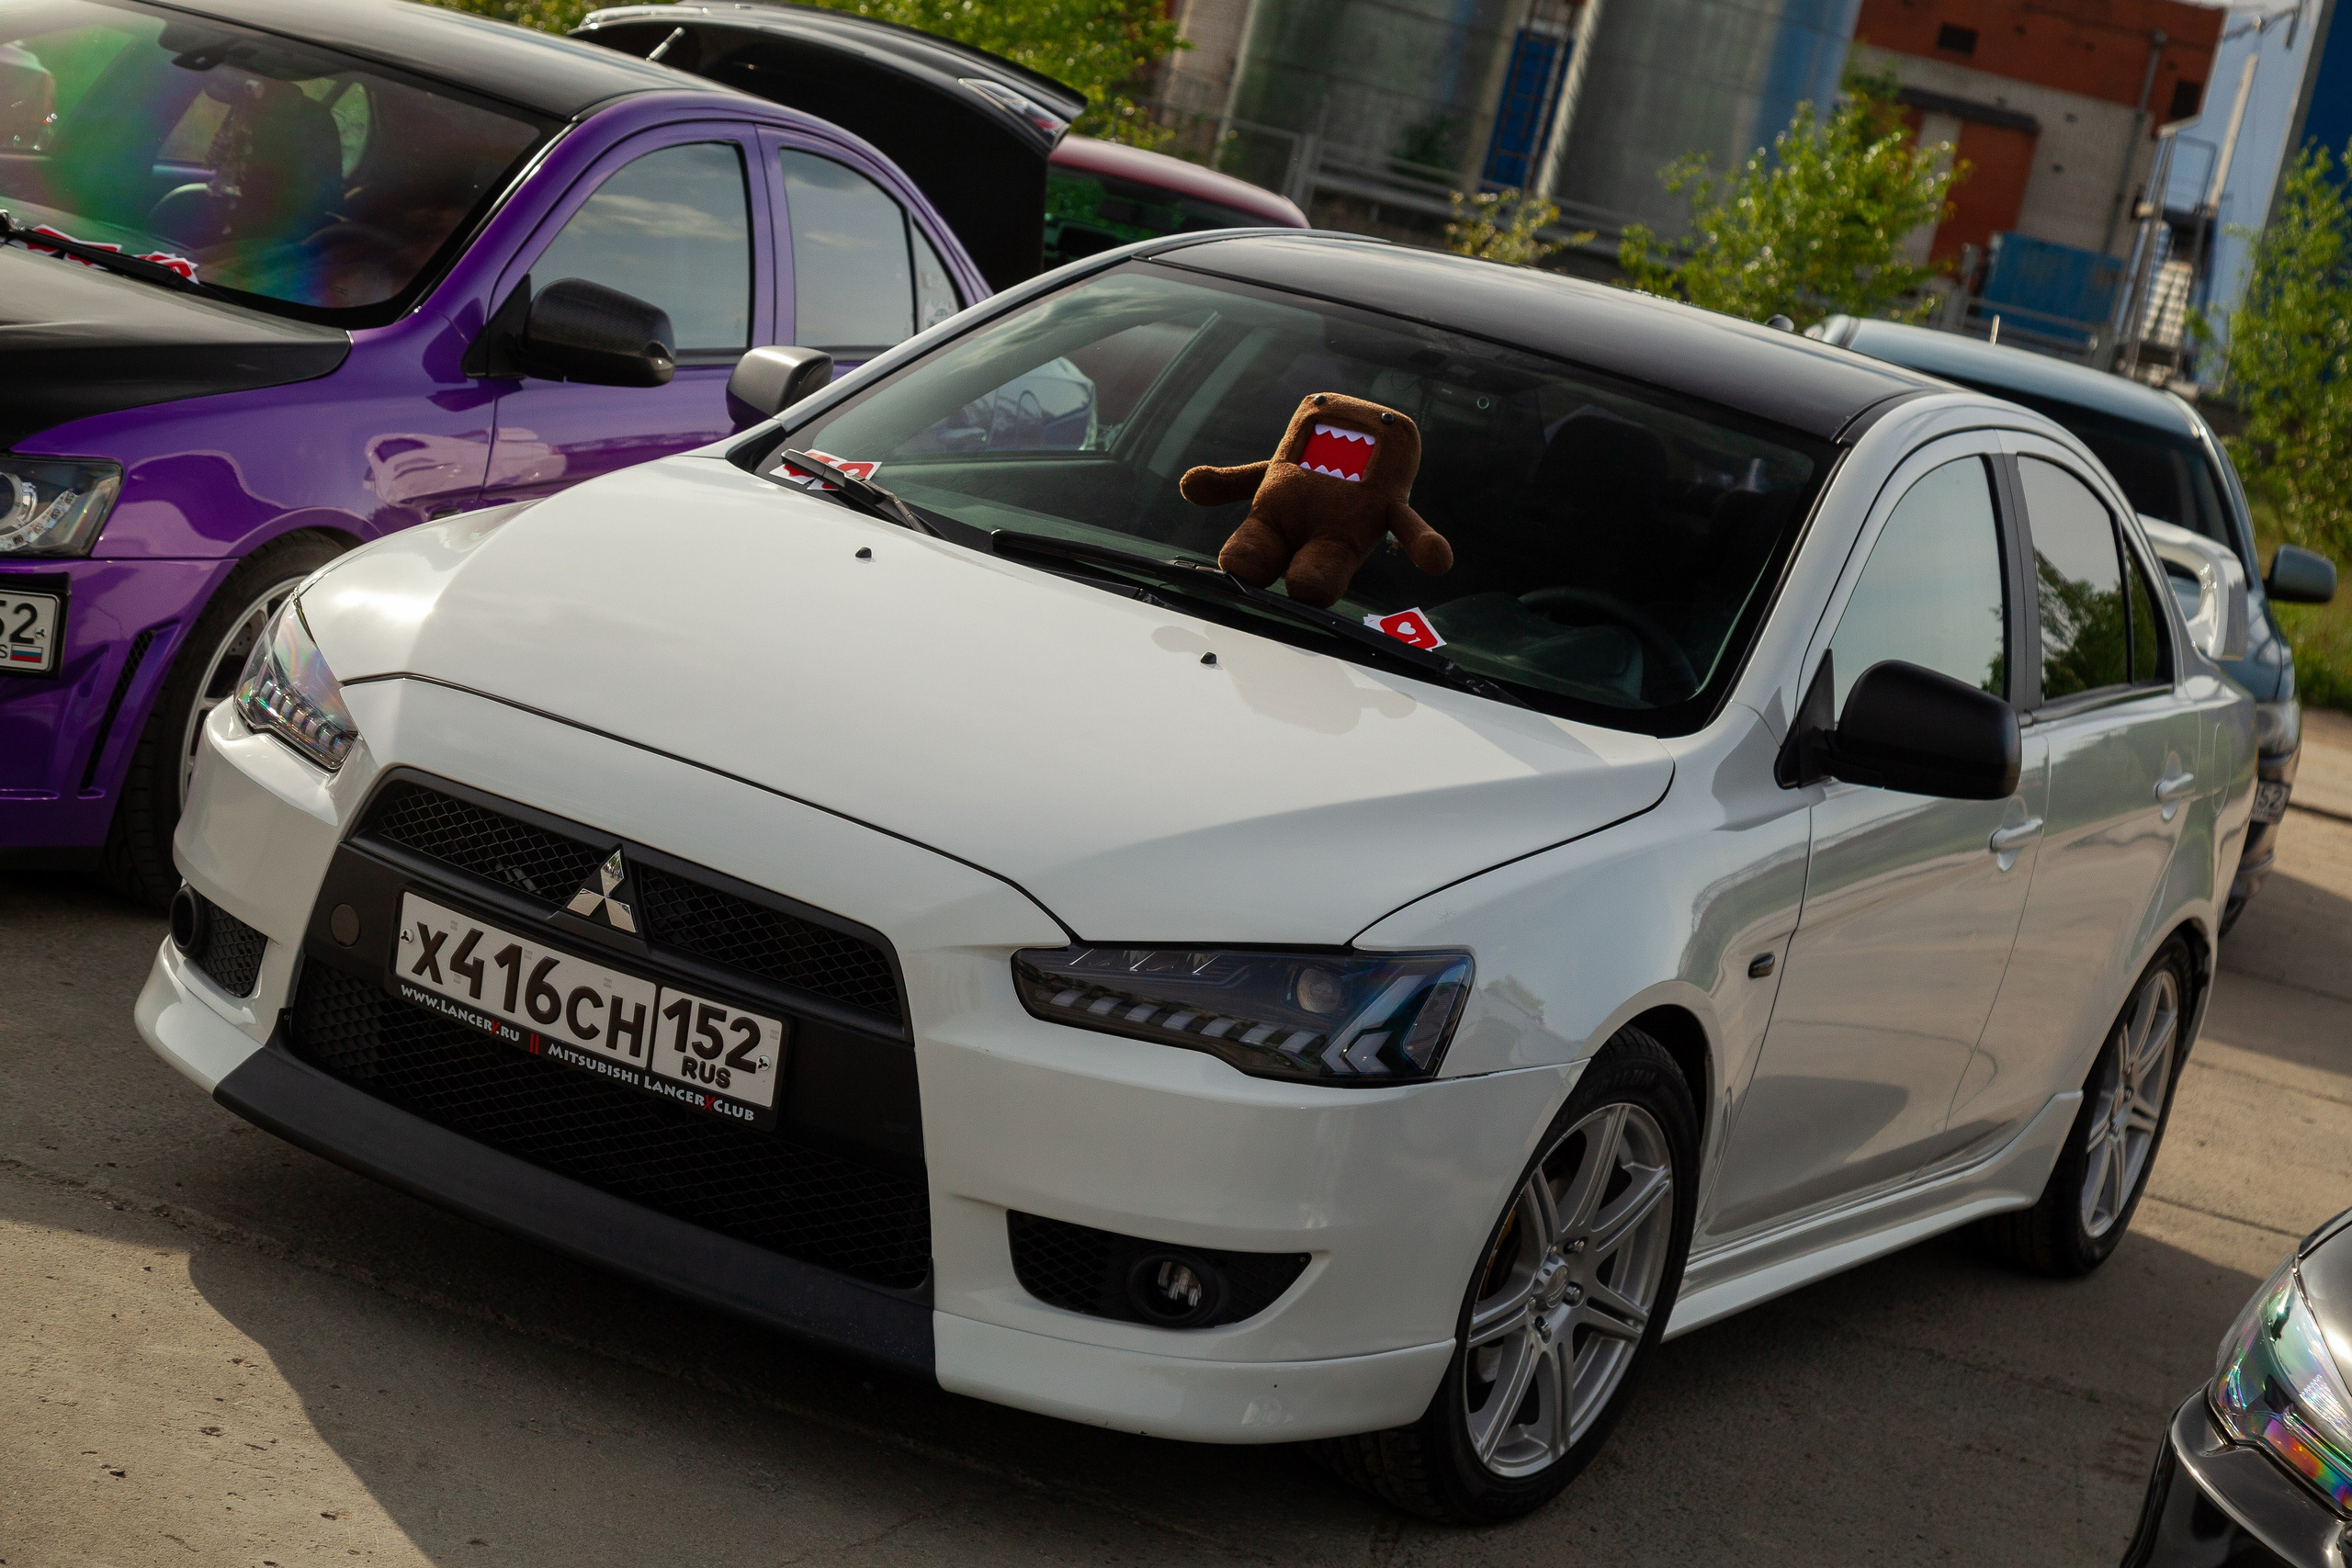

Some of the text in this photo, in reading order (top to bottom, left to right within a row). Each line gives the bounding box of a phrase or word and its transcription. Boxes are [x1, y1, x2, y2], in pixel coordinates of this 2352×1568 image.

[0, 599, 38, 644] 2
[662, 998, 761, 1075] 152
[548, 1043, 639, 1086] MITSUBISHI
[681, 1055, 731, 1089] RUS
